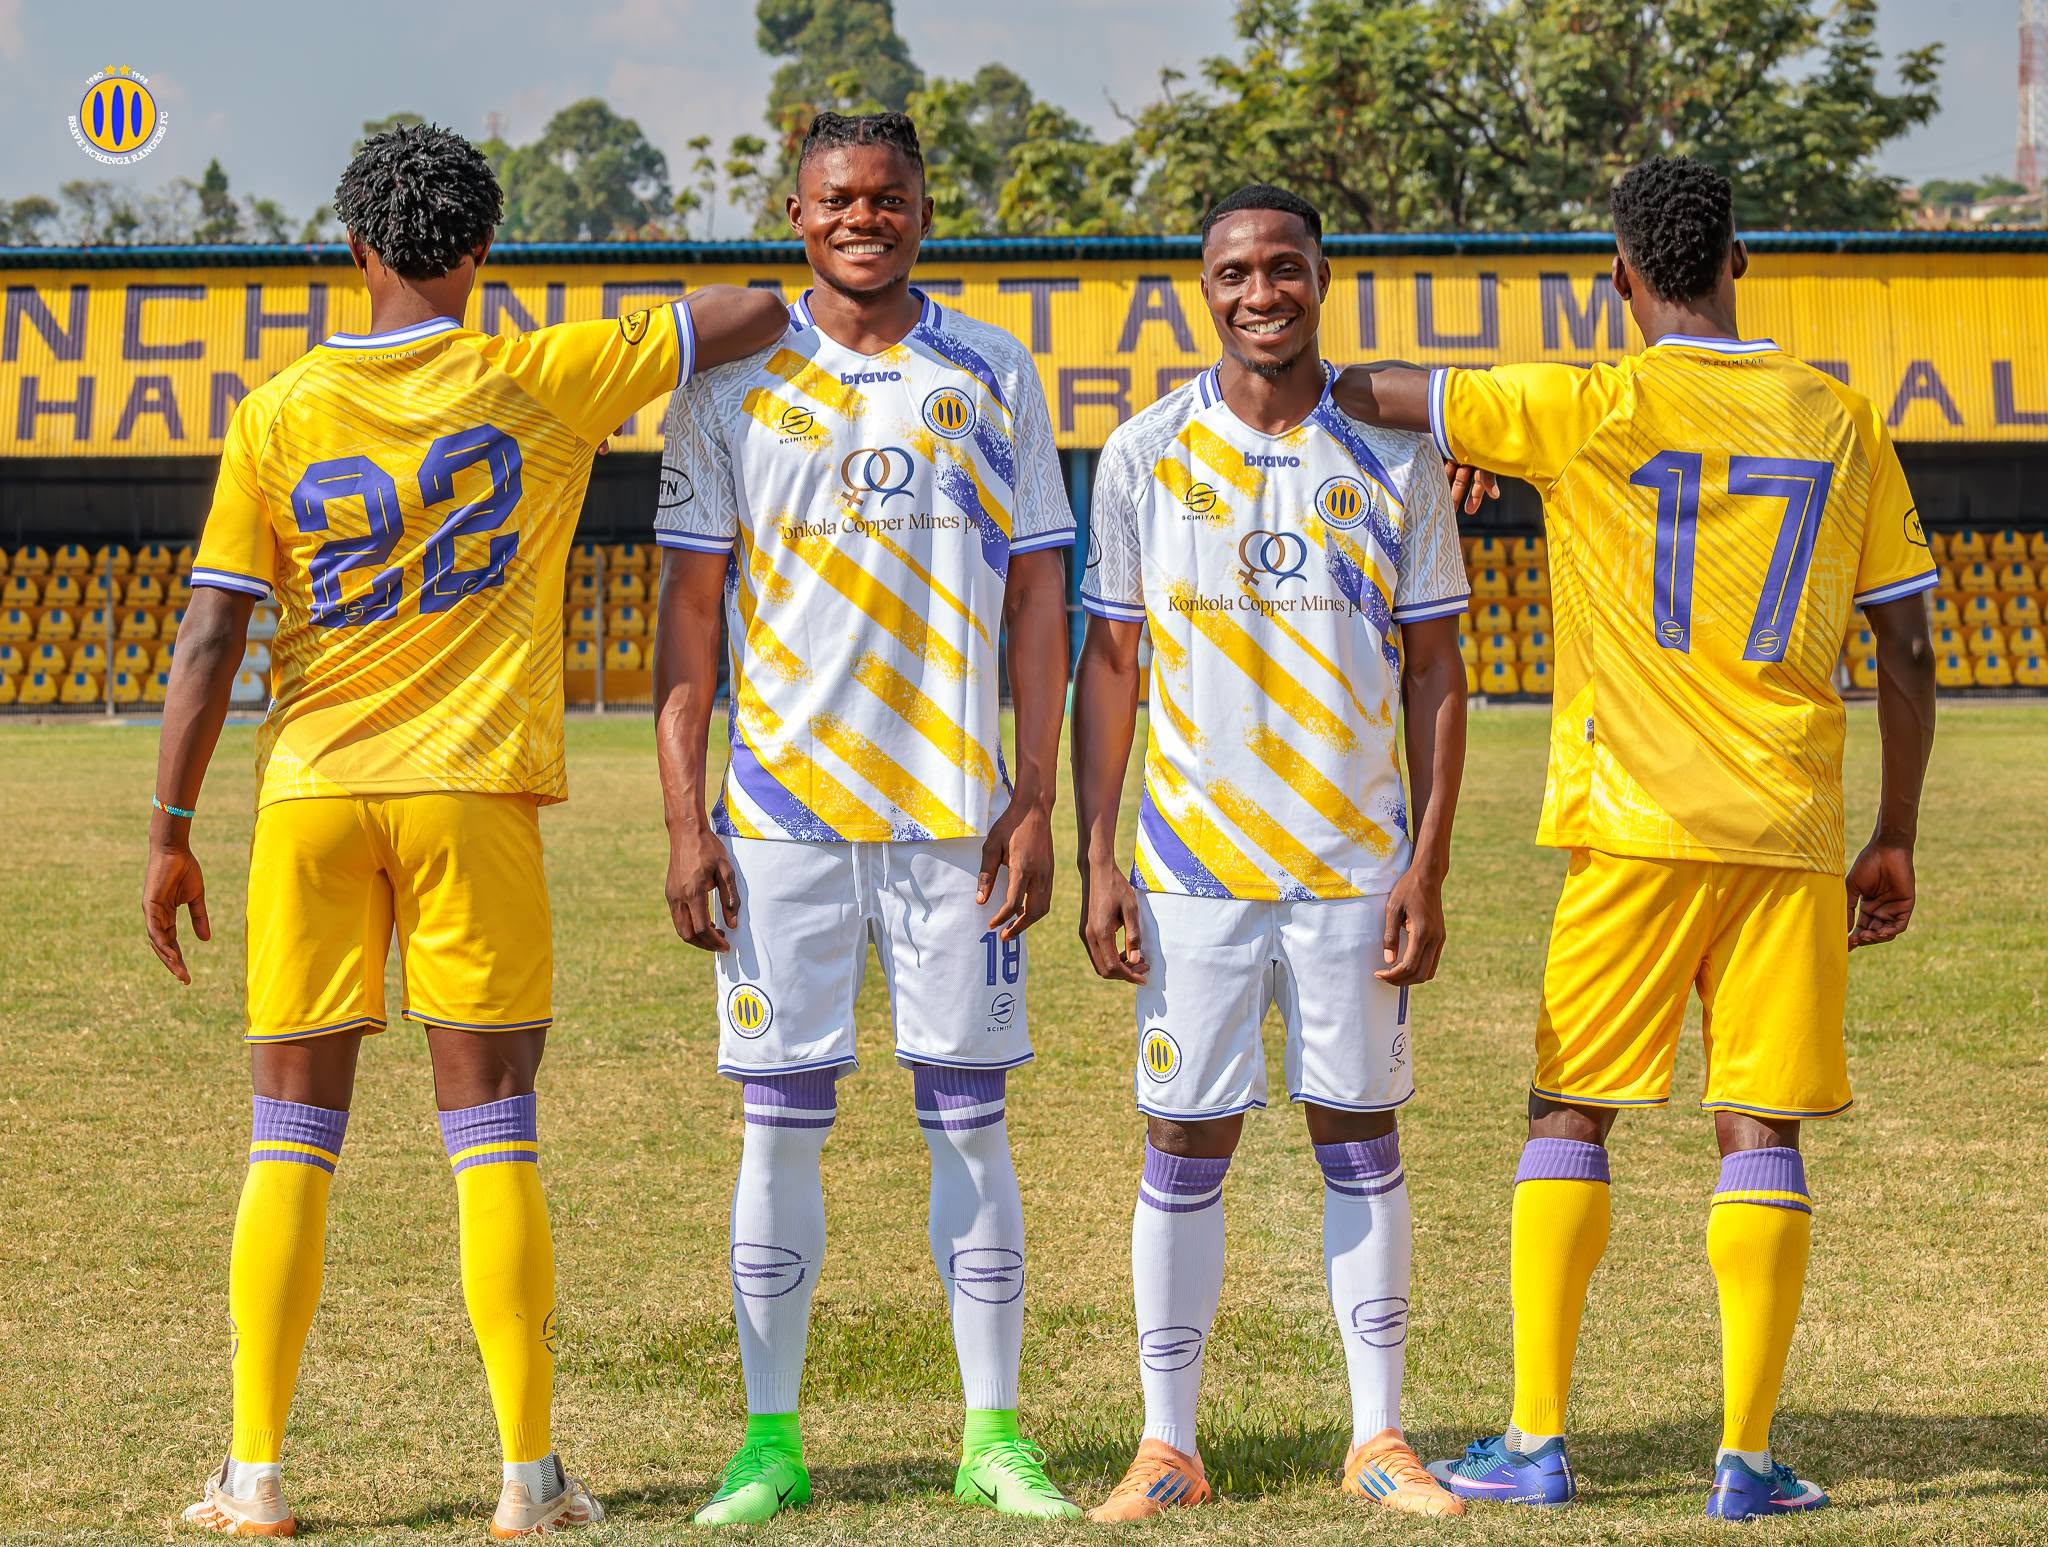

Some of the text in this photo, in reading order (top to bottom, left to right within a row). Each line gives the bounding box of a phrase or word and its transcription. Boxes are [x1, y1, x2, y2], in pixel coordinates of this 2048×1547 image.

[840, 371, 902, 386] bravo
[780, 434, 819, 445] SCIMITAR
[1243, 451, 1300, 468] bravo
[660, 480, 678, 497] TN
[291, 423, 523, 628] 22
[842, 515, 904, 537] Copper
[908, 513, 960, 530] Mines
[1629, 450, 1835, 662] 17
[1168, 594, 1233, 612] Konkola
[1238, 594, 1296, 617] Copper
[1301, 594, 1345, 613] Mines
[979, 931, 1020, 987] 18
